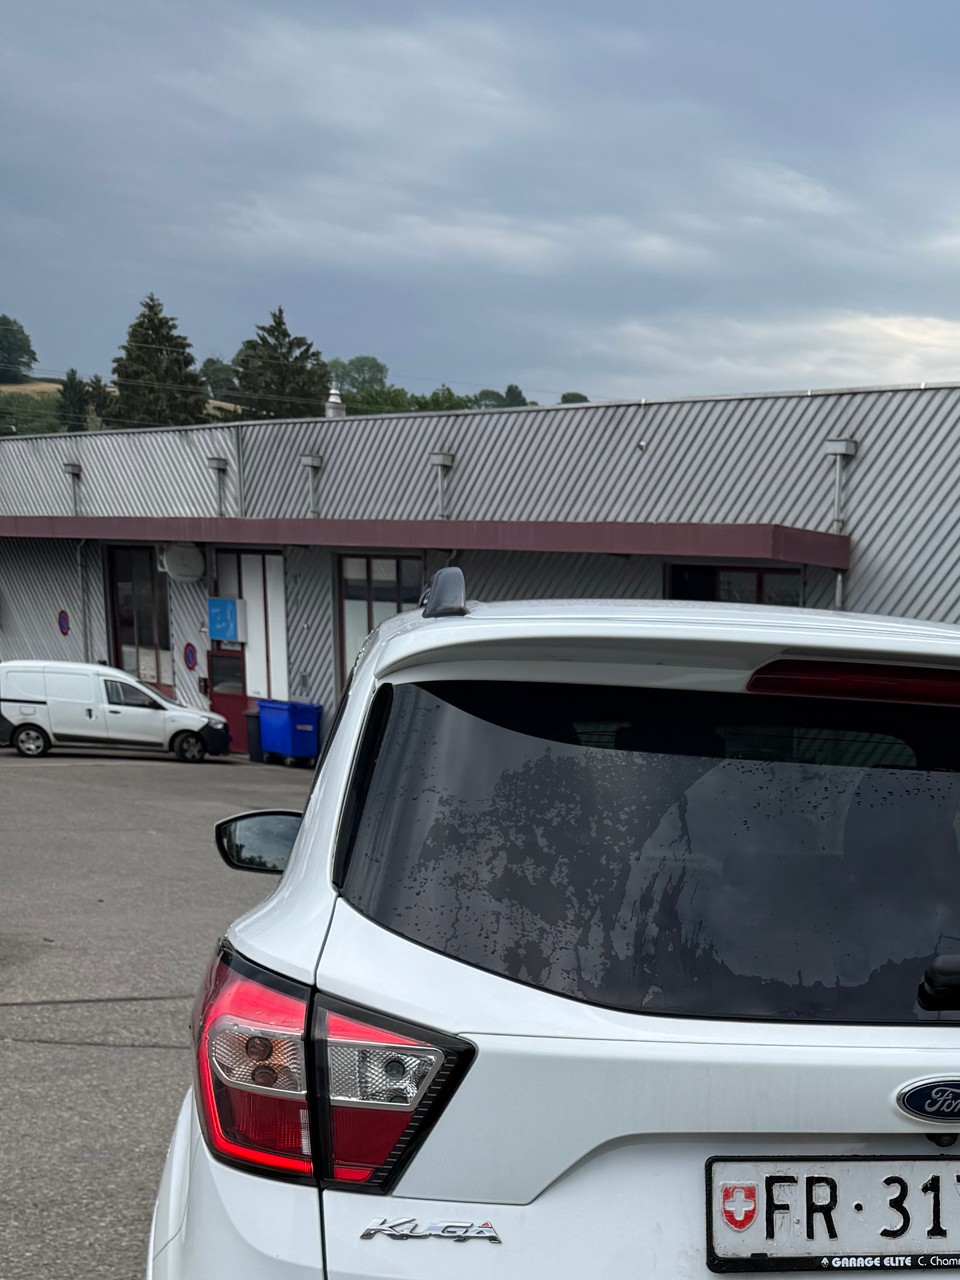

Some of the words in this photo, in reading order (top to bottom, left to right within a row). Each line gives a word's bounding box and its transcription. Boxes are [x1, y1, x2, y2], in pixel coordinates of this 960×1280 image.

[360, 1216, 503, 1244] KUGA
[831, 1256, 881, 1268] GARAGE
[883, 1256, 912, 1267] ELITE
[917, 1255, 927, 1266] C.
